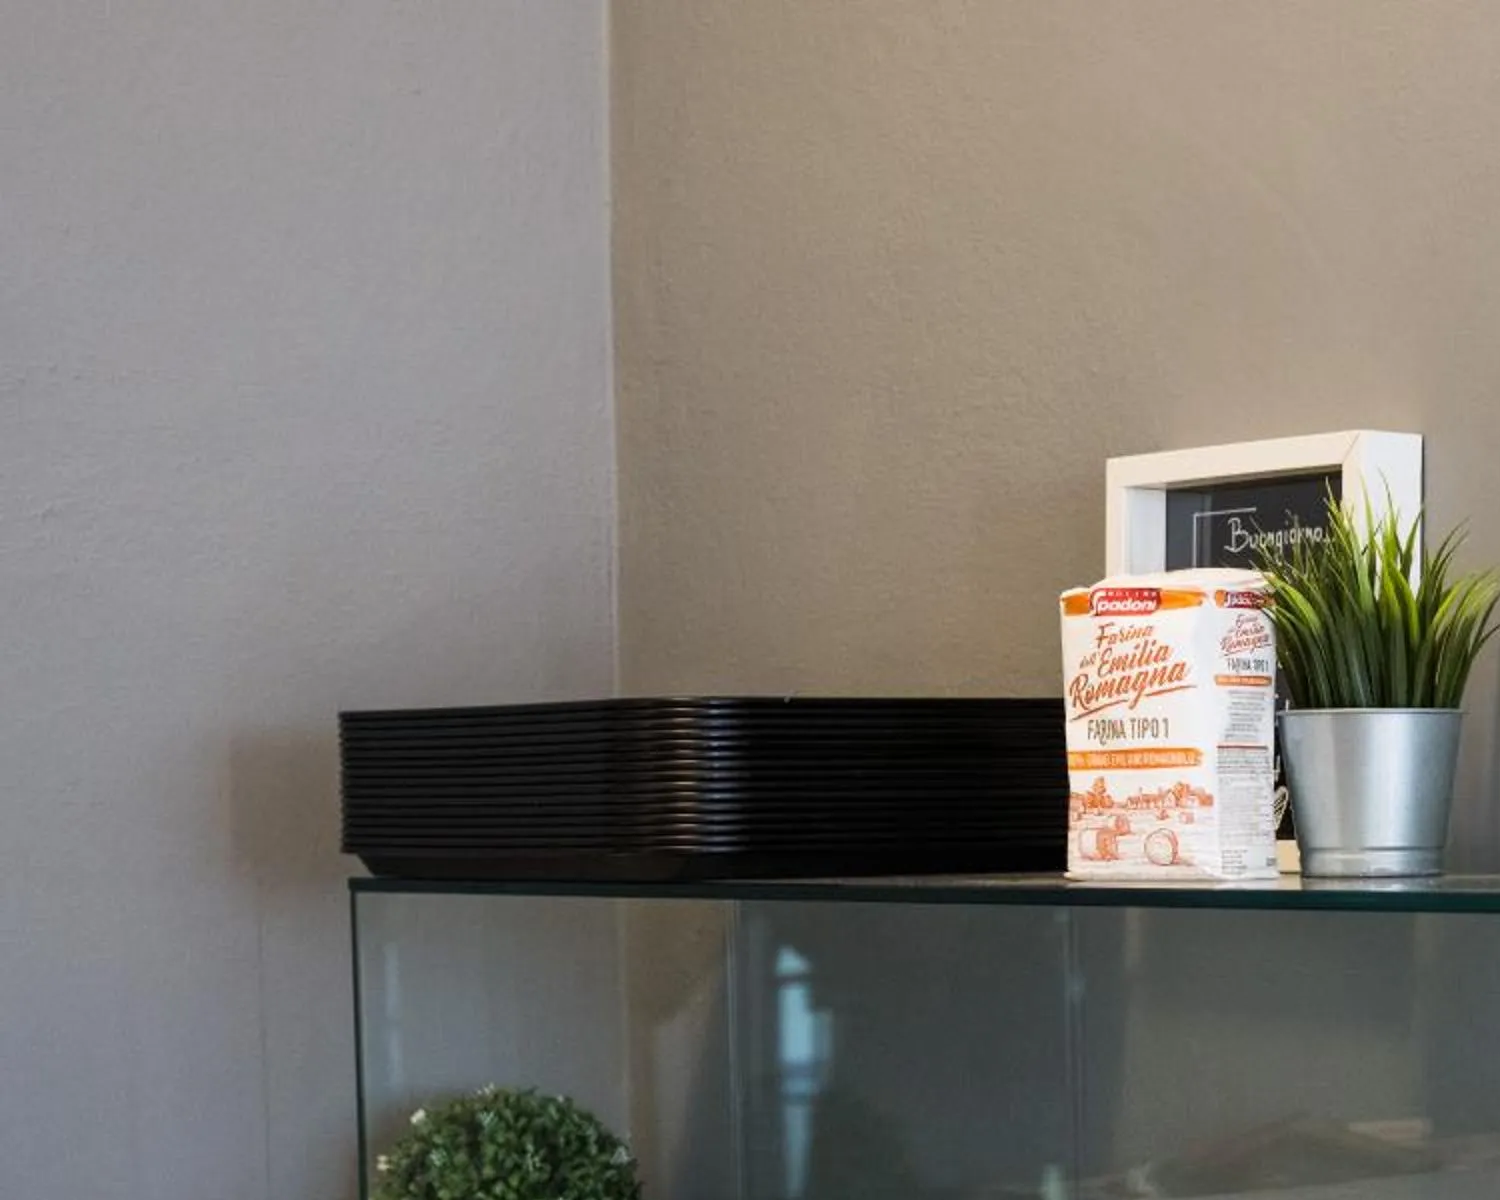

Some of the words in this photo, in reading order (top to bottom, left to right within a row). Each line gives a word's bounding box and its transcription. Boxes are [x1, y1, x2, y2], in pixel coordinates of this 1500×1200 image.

[1096, 622, 1153, 648] Farina
[1070, 662, 1186, 711] Romagna
[1088, 719, 1127, 745] FARINA
[1130, 718, 1159, 739] TIPO
[1162, 718, 1169, 738] 1
